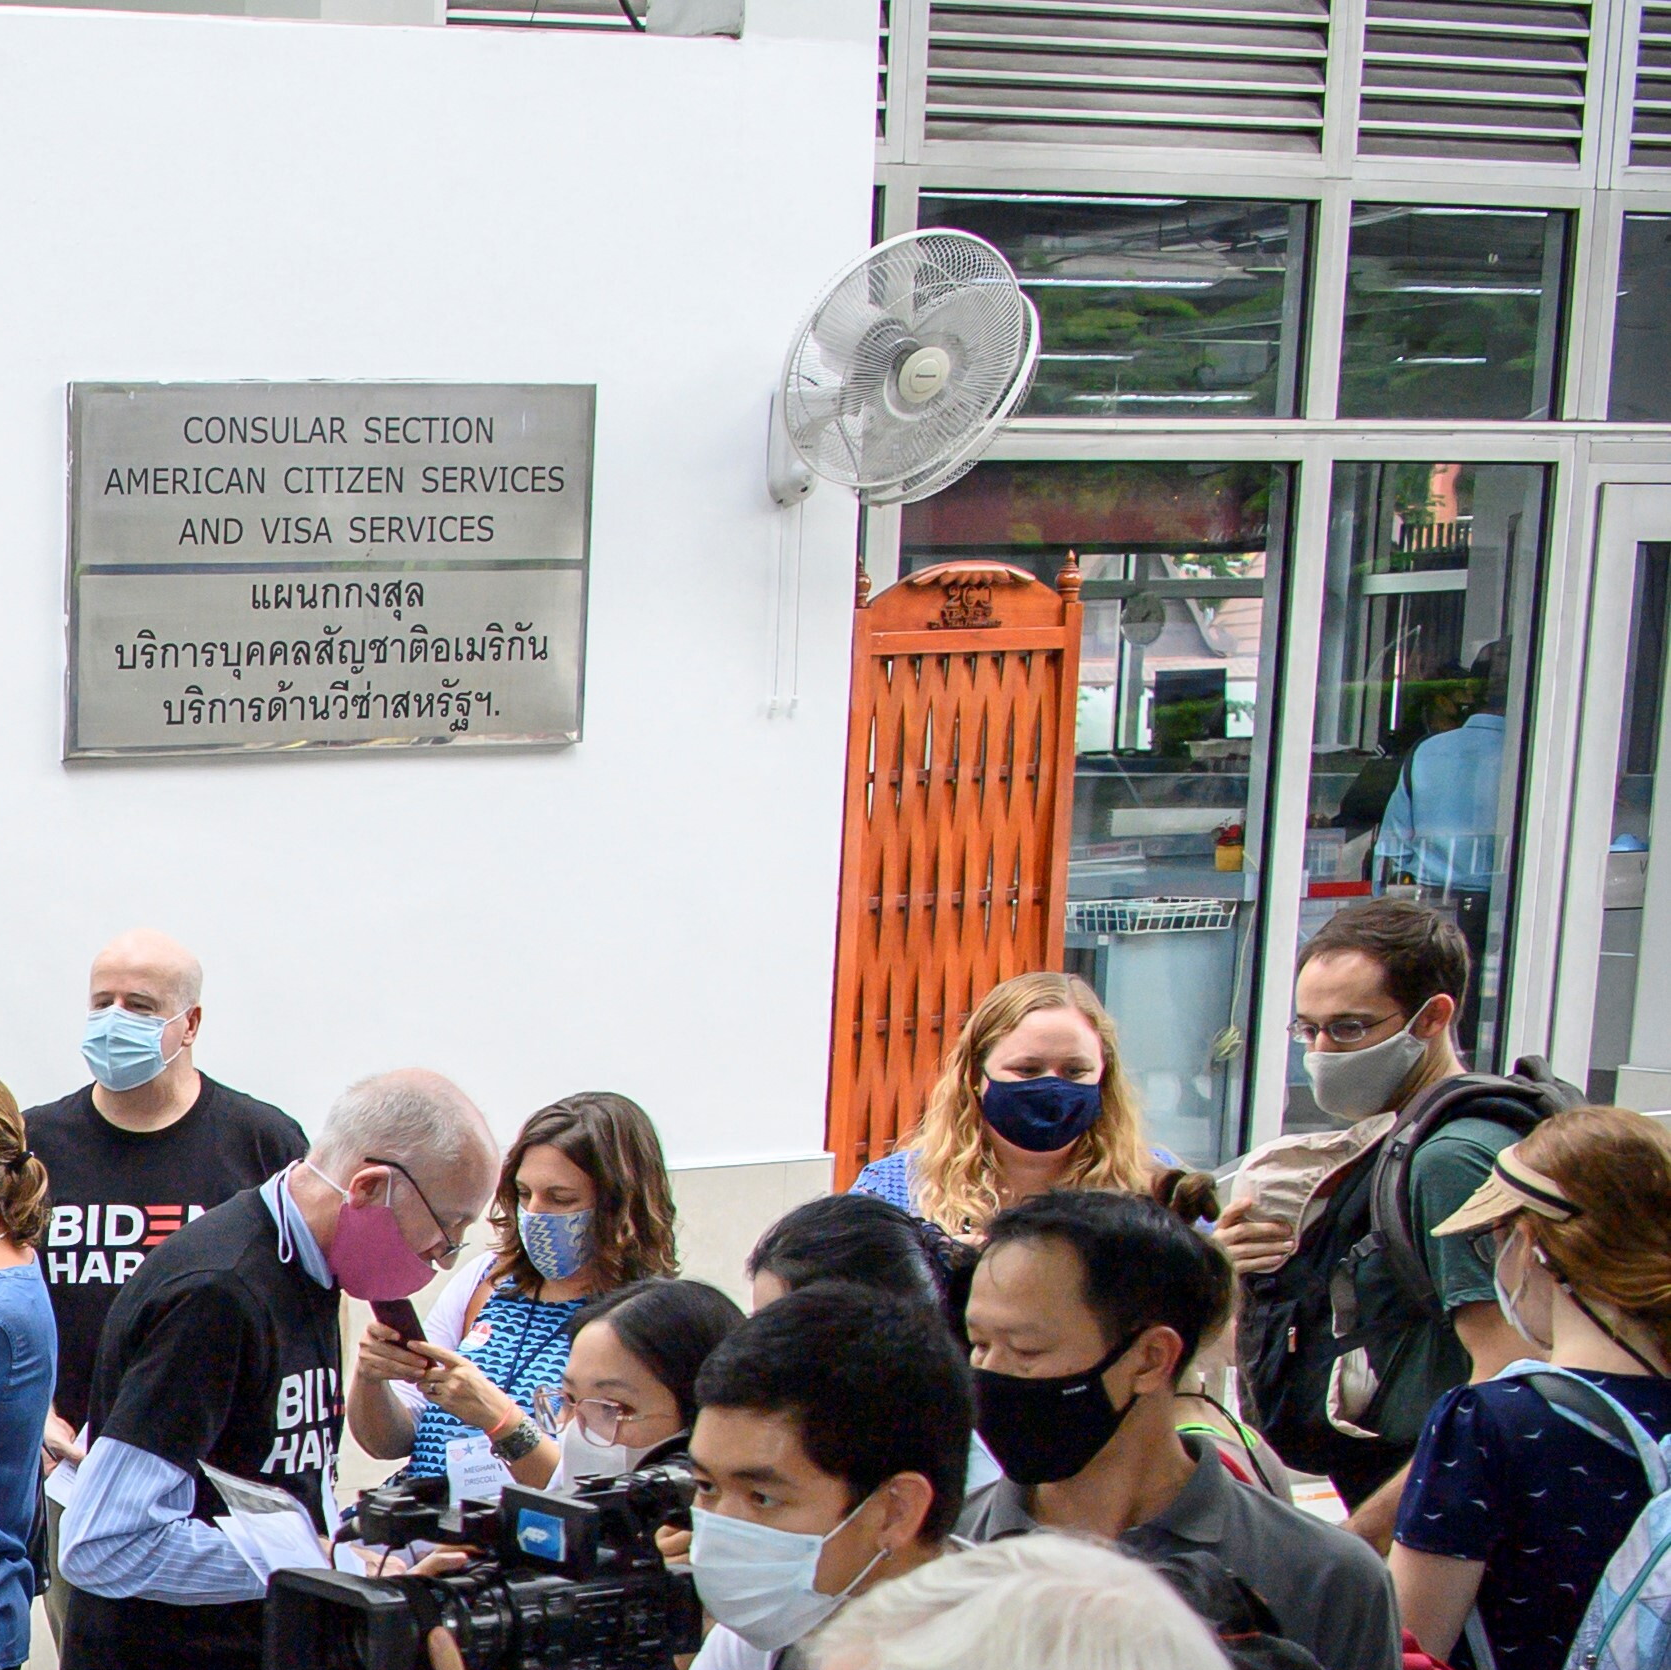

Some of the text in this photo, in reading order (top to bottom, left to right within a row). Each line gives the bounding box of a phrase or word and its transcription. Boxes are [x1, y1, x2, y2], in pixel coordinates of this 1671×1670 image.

[182, 416, 495, 445] CONSULAR SECTION
[104, 465, 565, 495] AMERICAN CITIZEN SERVICES
[178, 515, 495, 545] AND VISA SERVICES
[251, 578, 425, 619] แผนกกงสุล
[114, 622, 548, 680] บริการบุคคลสัญชาติอเมริกัน
